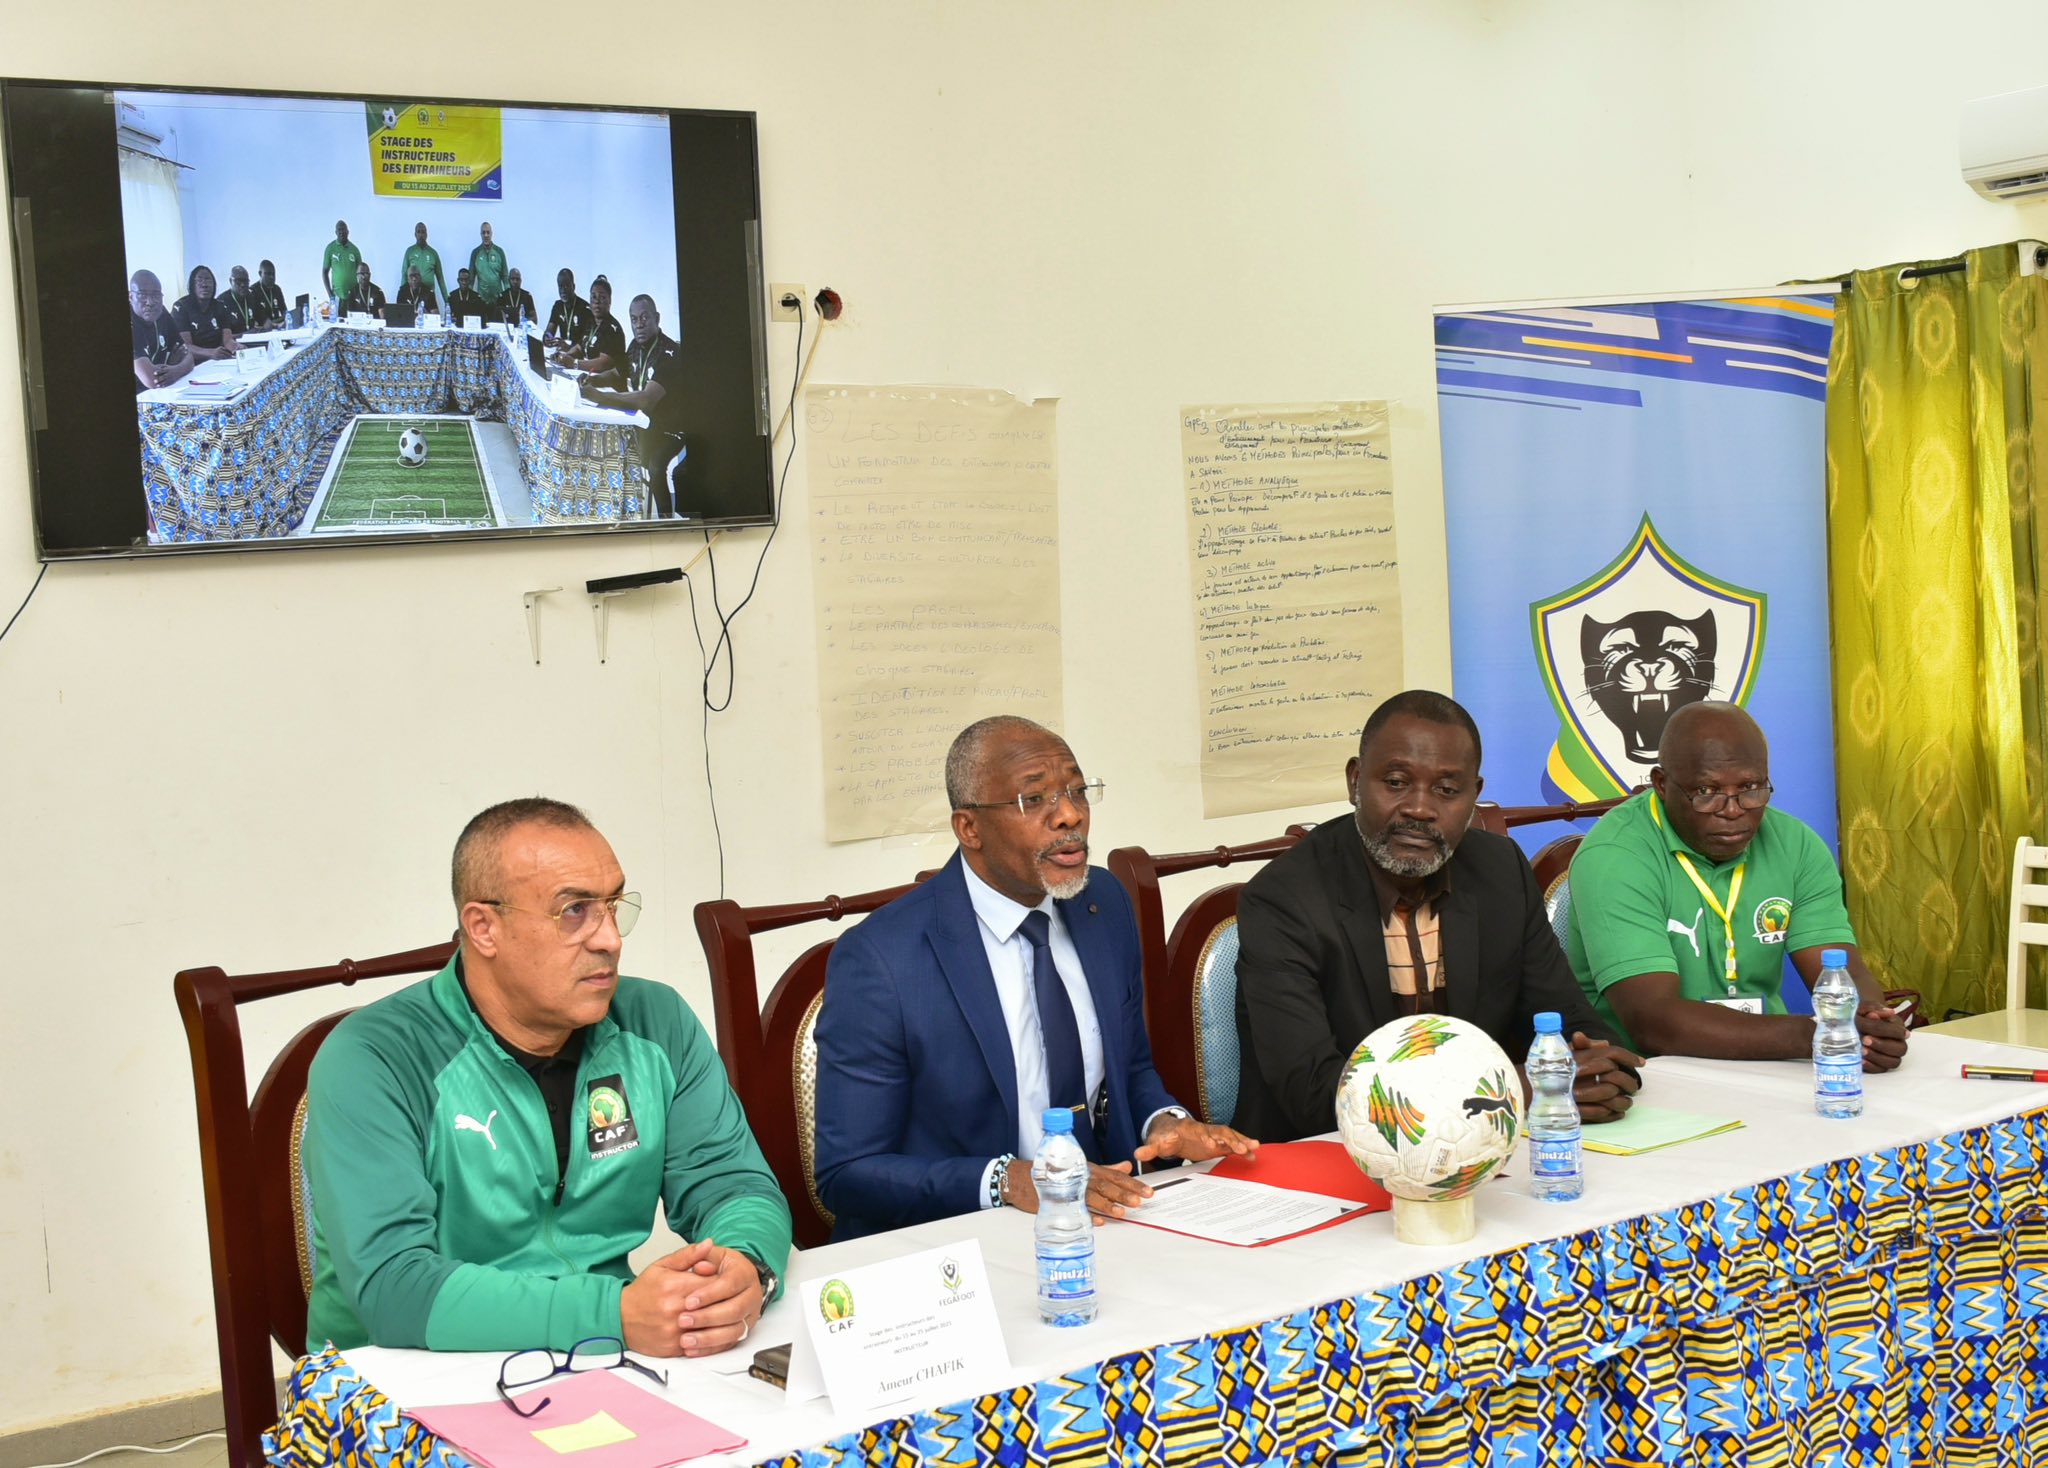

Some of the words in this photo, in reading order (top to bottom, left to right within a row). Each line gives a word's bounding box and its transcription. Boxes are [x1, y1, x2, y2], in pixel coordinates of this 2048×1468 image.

[380, 136, 412, 148] STAGE
[414, 138, 433, 148] DES
[382, 150, 456, 162] INSTRUCTEURS
[382, 164, 402, 174] DES
[403, 164, 472, 176] ENTRAINEURS
[594, 1125, 626, 1143] CAF
[591, 1141, 639, 1160] INSTRUCTOR
[938, 1290, 976, 1307] FEGAFOOT
[828, 1318, 856, 1334] CAF
[916, 1358, 966, 1382] CHAFIK
